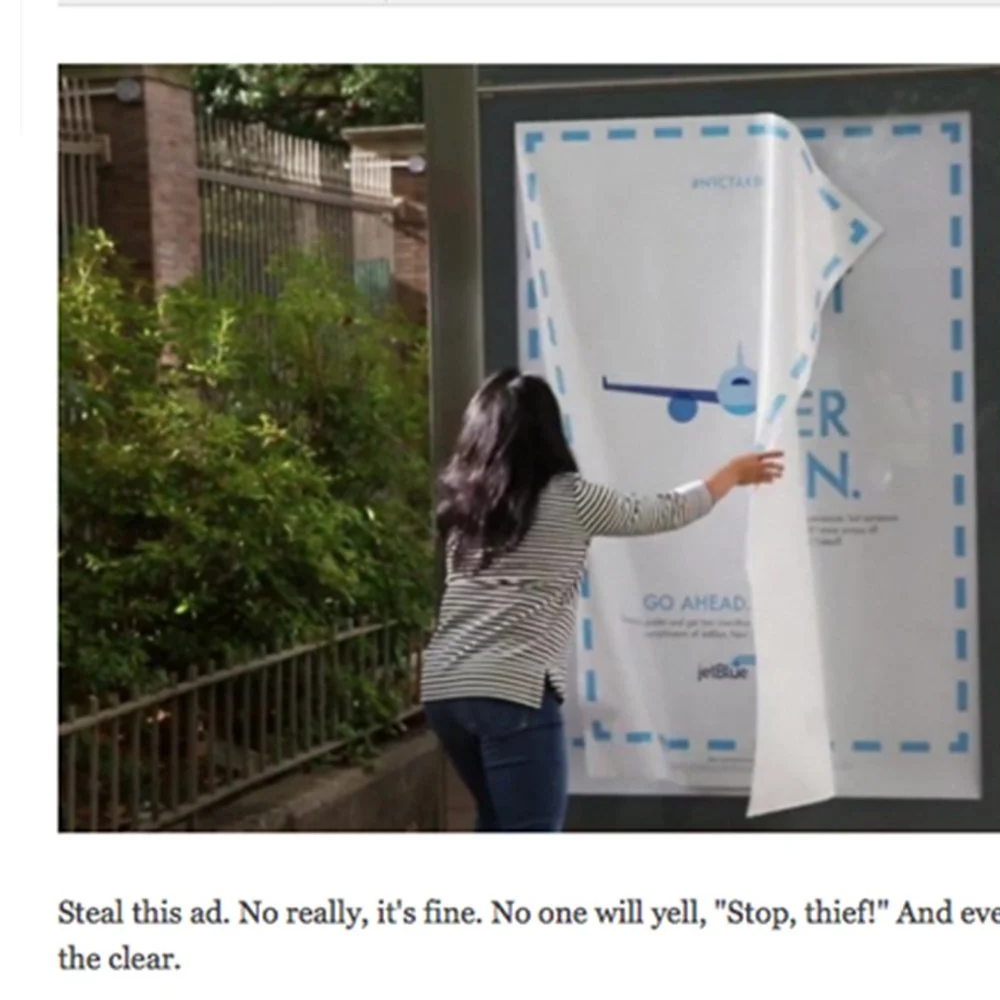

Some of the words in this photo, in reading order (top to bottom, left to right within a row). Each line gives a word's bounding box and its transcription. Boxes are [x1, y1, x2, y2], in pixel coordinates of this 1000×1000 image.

[643, 594, 674, 611] GO
[697, 661, 748, 682] jetBlue
[58, 898, 124, 924] Steal
[132, 898, 182, 924] this
[190, 898, 229, 924] ad.
[238, 900, 278, 924] No
[286, 898, 368, 930] really,
[377, 899, 416, 924] it's
[423, 898, 482, 924] fine.
[491, 900, 531, 924] No
[538, 907, 588, 924] one
[594, 898, 644, 924] will
[651, 898, 706, 930] yell,
[715, 899, 796, 930] "Stop,
[805, 898, 889, 924] thief!"
[896, 898, 953, 924] And
[58, 944, 101, 970] the
[108, 944, 181, 970] clear.
